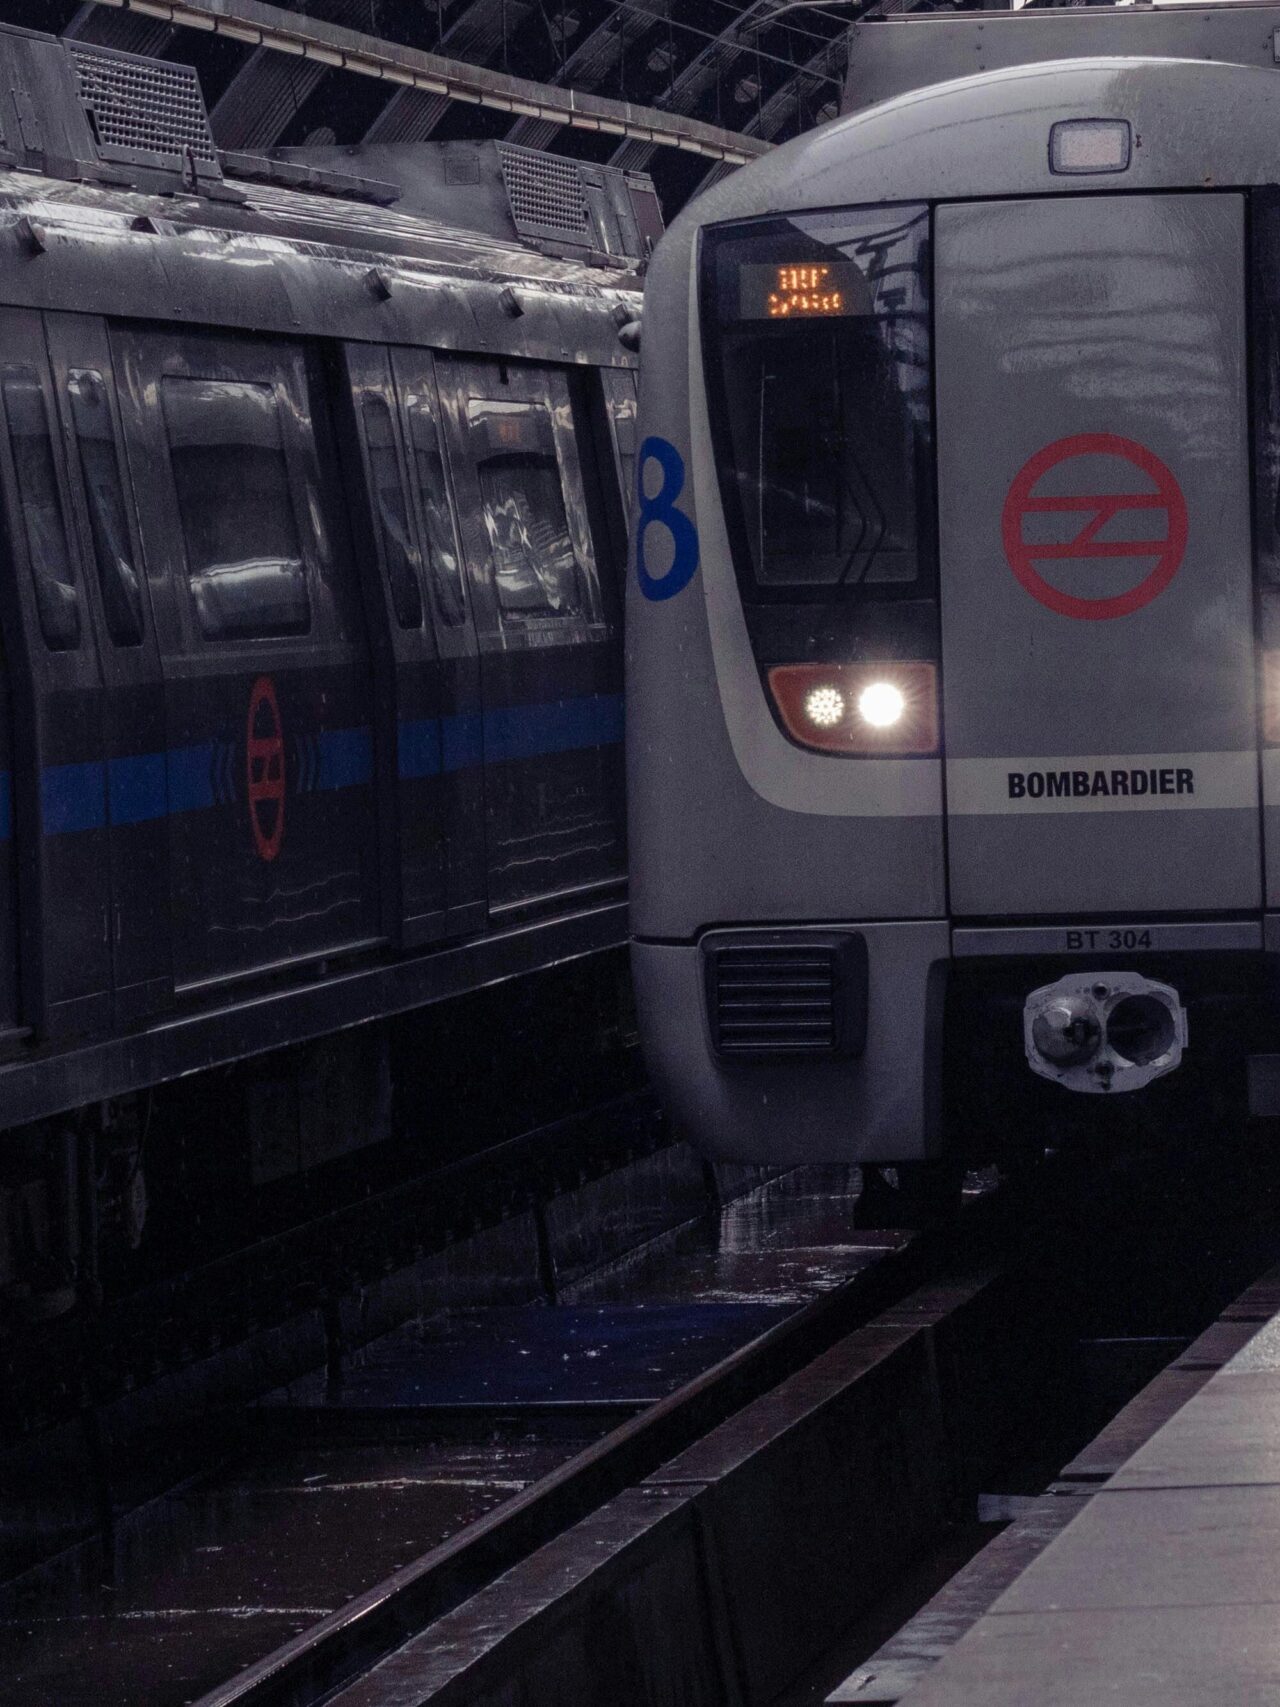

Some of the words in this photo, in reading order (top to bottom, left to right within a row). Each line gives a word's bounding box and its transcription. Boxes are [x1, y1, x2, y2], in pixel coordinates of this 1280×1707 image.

[636, 436, 700, 602] 8
[1007, 768, 1195, 799] BOMBARDIER
[1066, 930, 1099, 950] BT
[1108, 929, 1152, 949] 304
